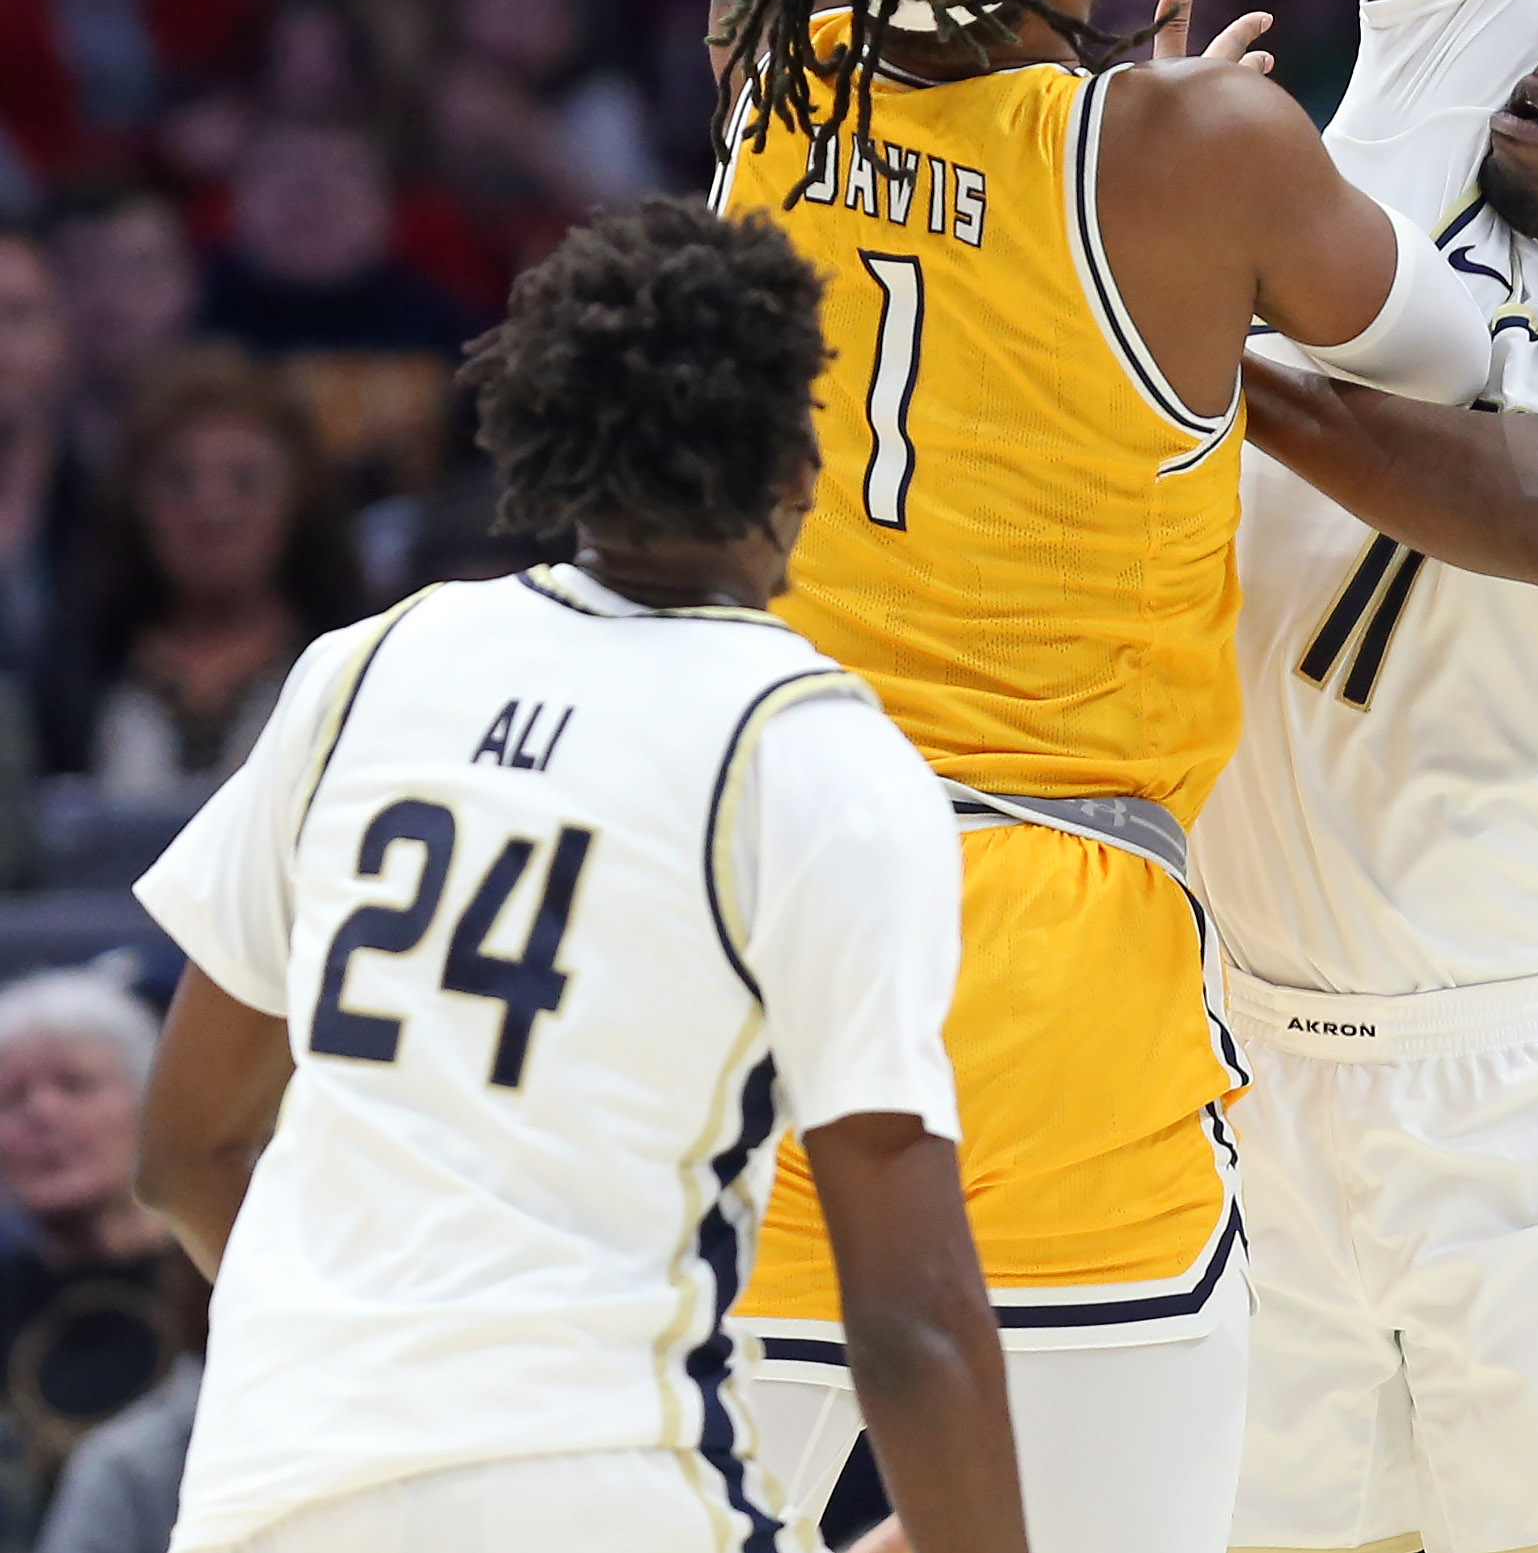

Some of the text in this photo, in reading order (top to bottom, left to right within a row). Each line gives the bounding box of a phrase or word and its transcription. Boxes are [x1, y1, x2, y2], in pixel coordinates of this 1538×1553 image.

[804, 124, 987, 248] DAVIS
[857, 248, 924, 531] 1
[471, 699, 576, 772] ALI
[307, 796, 598, 1091] 24
[1287, 1016, 1377, 1038] AKRON
